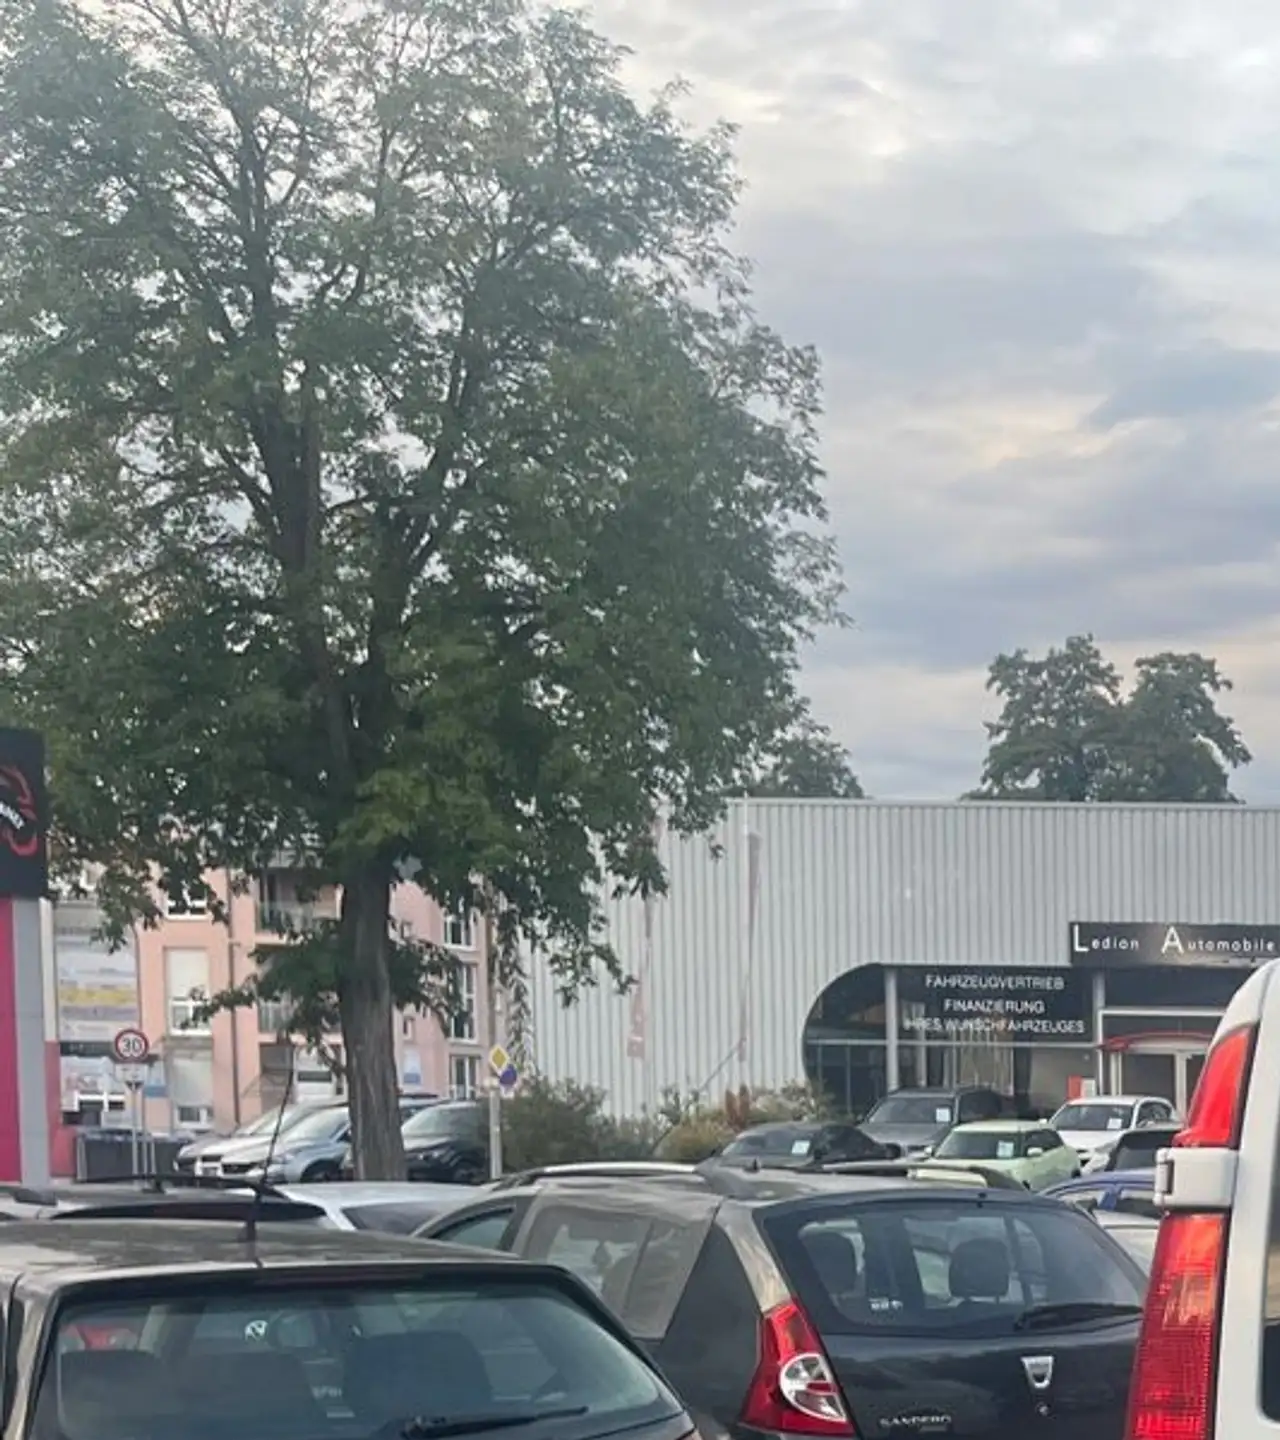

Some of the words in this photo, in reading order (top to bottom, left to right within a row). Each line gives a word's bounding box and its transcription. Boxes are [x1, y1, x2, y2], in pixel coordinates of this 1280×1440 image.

[1073, 924, 1140, 952] Ledion
[1161, 925, 1276, 954] Automobile
[925, 974, 1065, 991] FAHRZEUGVERTRIEB
[943, 998, 1045, 1015] FINANZIERUNG
